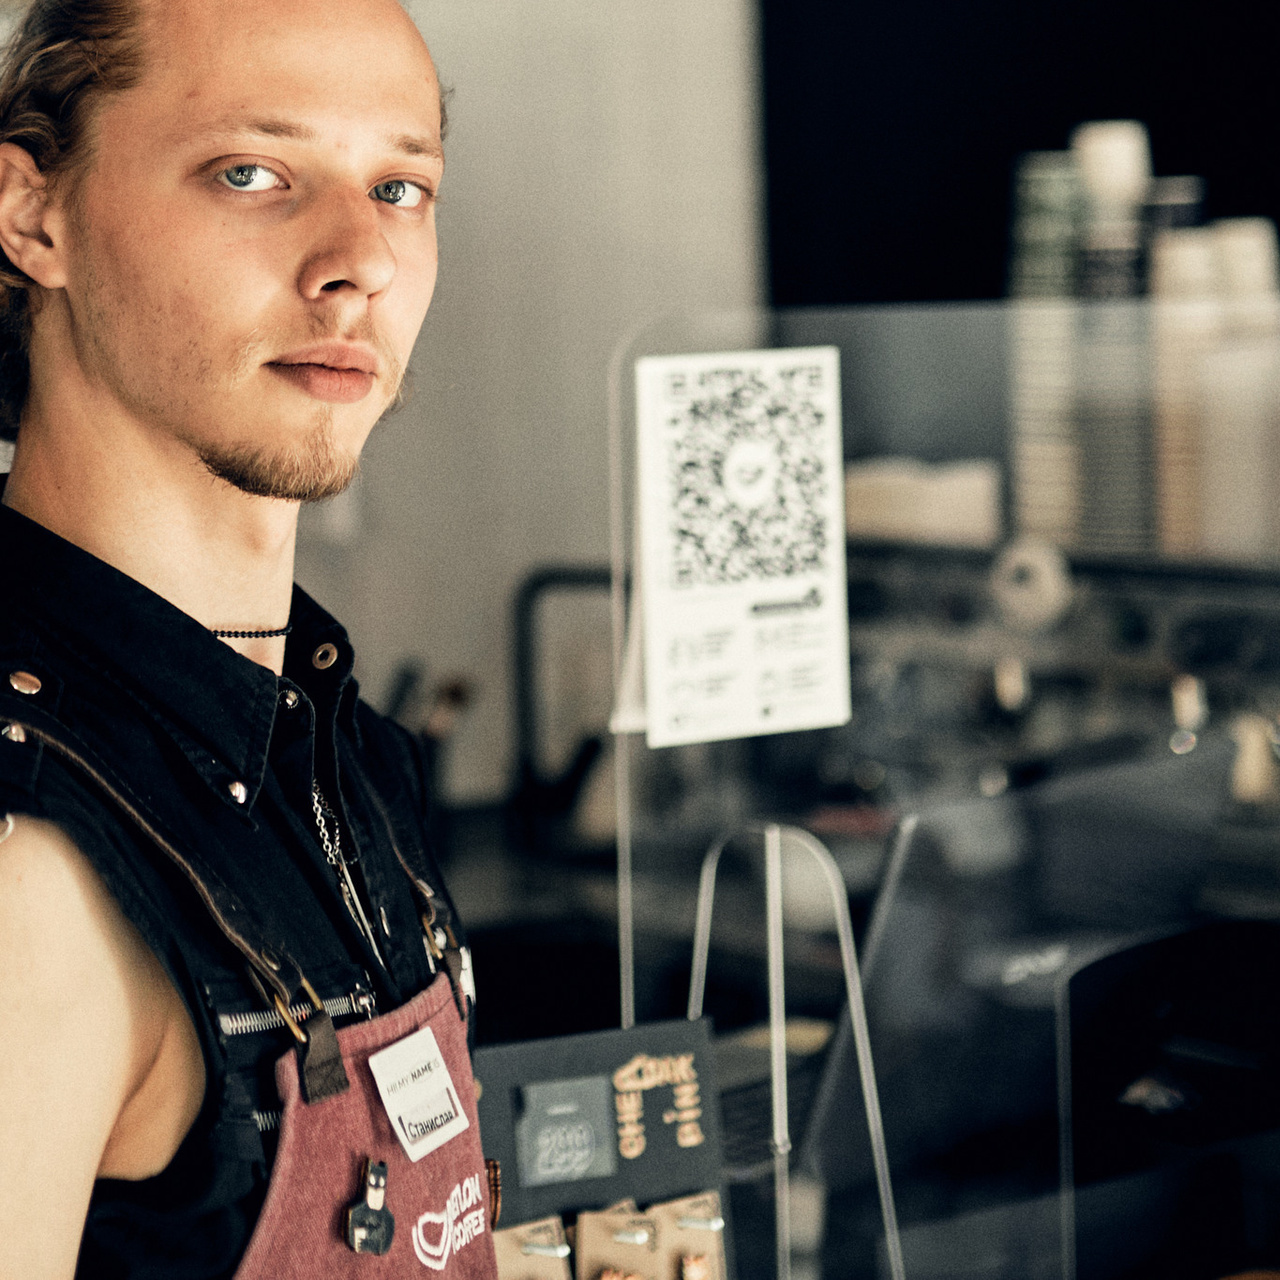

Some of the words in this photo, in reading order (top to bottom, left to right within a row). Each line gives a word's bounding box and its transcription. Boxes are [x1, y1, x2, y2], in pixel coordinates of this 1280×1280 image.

[410, 1061, 433, 1082] NAME
[407, 1110, 454, 1139] Станислав
[452, 1207, 485, 1254] COFFEE
